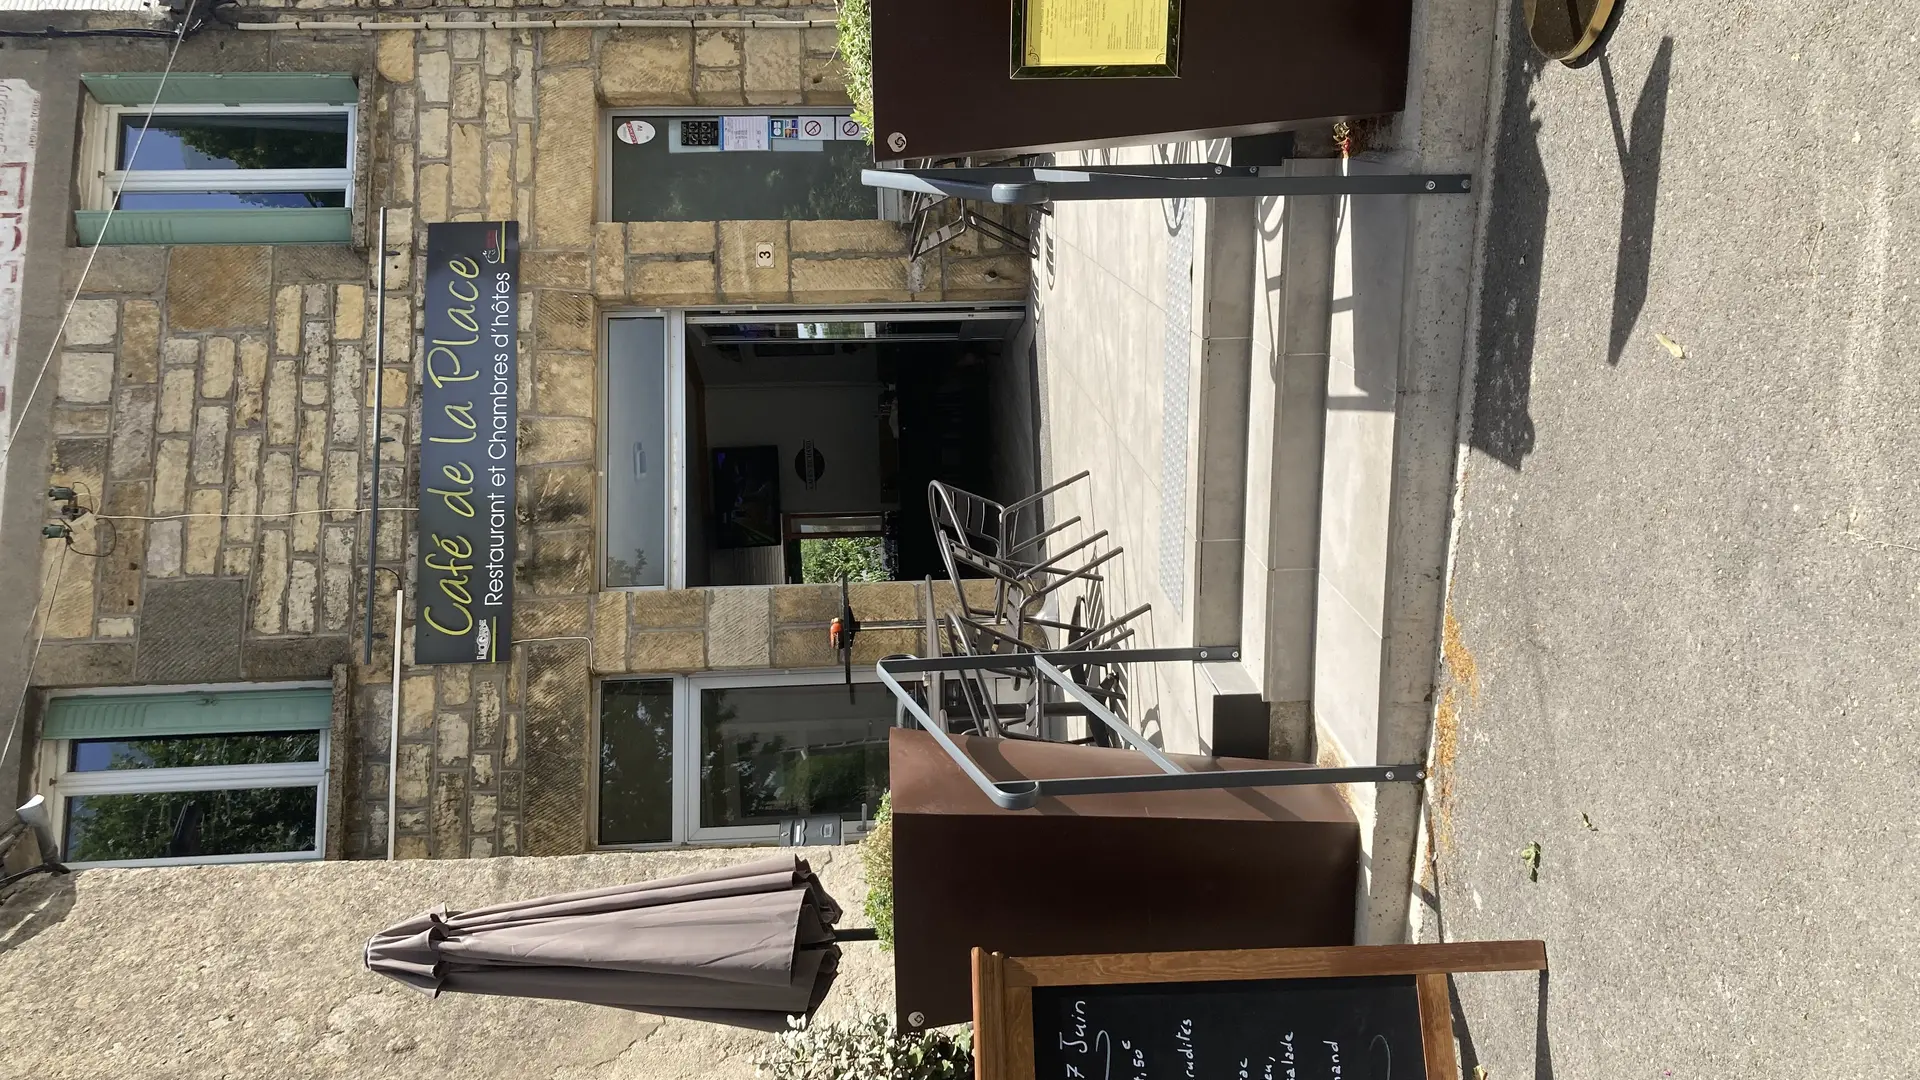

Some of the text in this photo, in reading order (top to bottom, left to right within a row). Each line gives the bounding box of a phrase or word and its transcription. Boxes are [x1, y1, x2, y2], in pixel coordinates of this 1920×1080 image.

[759, 251, 771, 259] 3
[424, 256, 480, 635] Café de la Place
[488, 353, 509, 459] Chambres
[488, 465, 506, 487] et
[485, 492, 505, 606] Restaurant
[1059, 1000, 1088, 1078] 7 Juin
